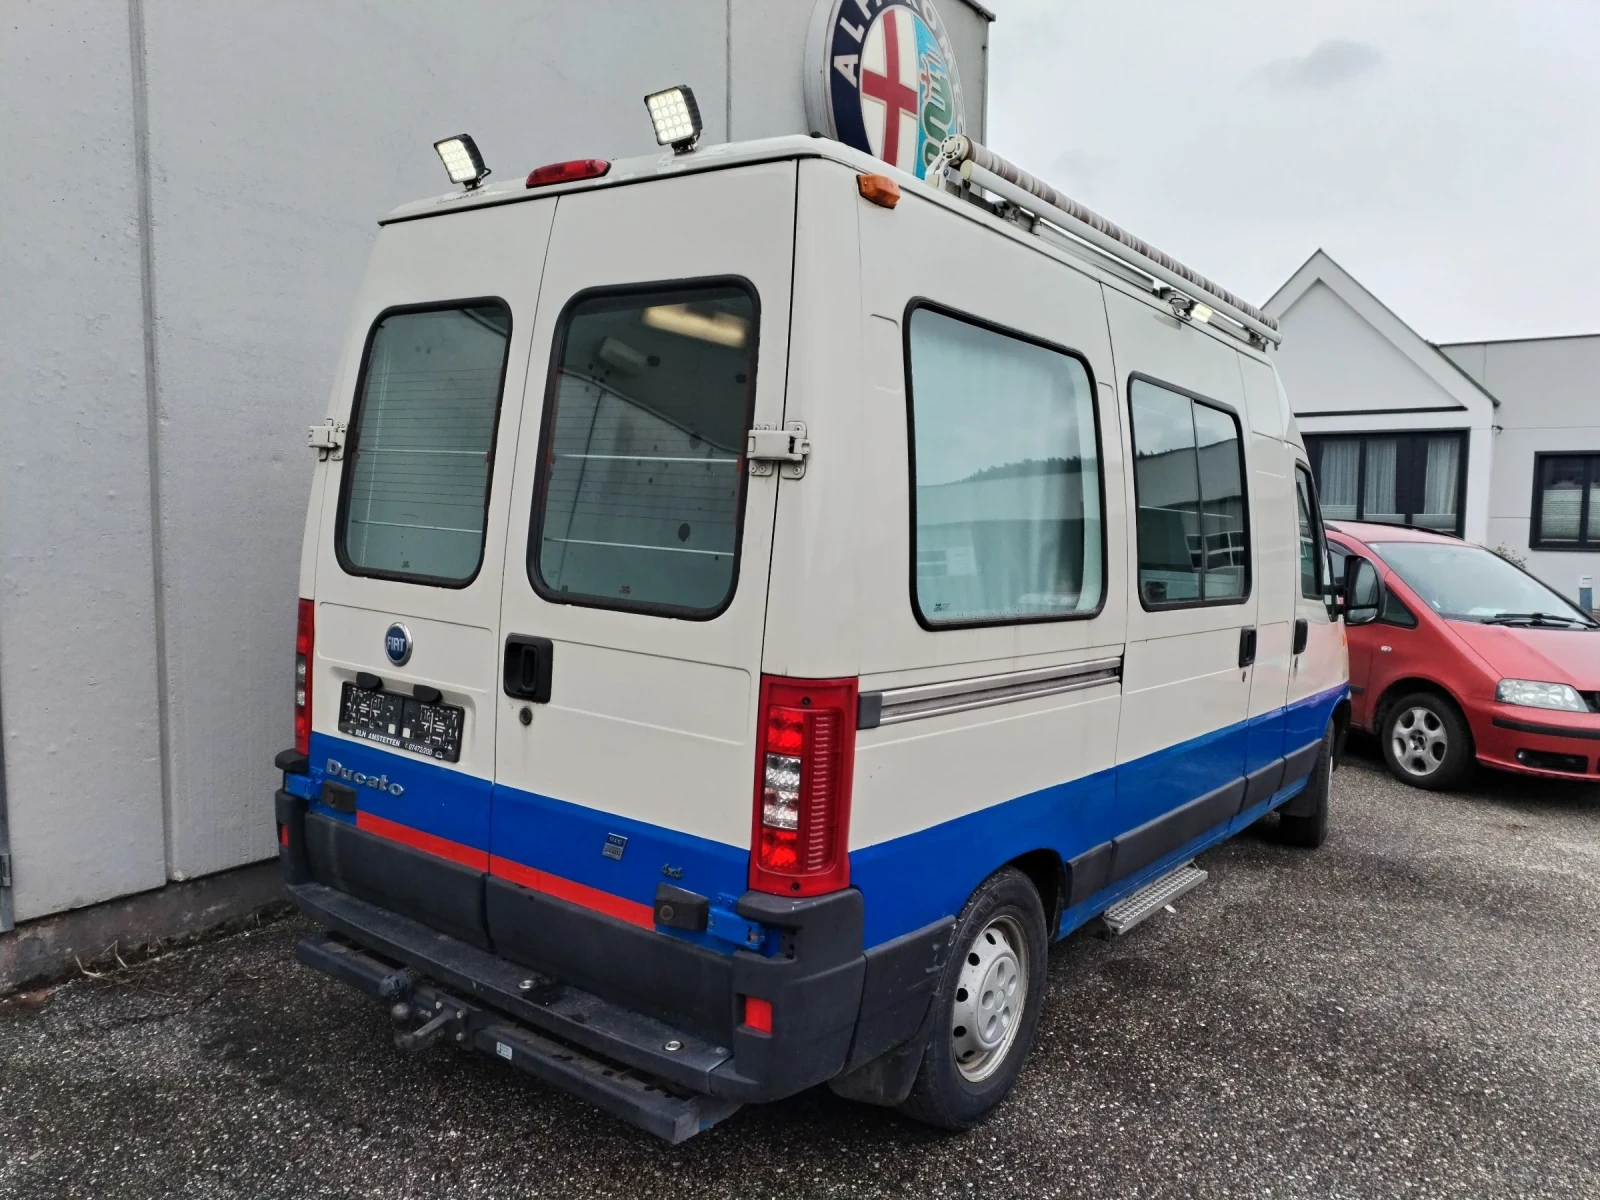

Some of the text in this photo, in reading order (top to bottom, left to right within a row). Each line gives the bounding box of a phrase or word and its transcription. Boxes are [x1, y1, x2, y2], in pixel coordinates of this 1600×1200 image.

[834, 0, 883, 88] ALF
[387, 636, 405, 652] FIAT
[367, 732, 401, 747] AMSTETTEN
[326, 758, 404, 796] Ducato
[661, 863, 683, 879] 4x4
